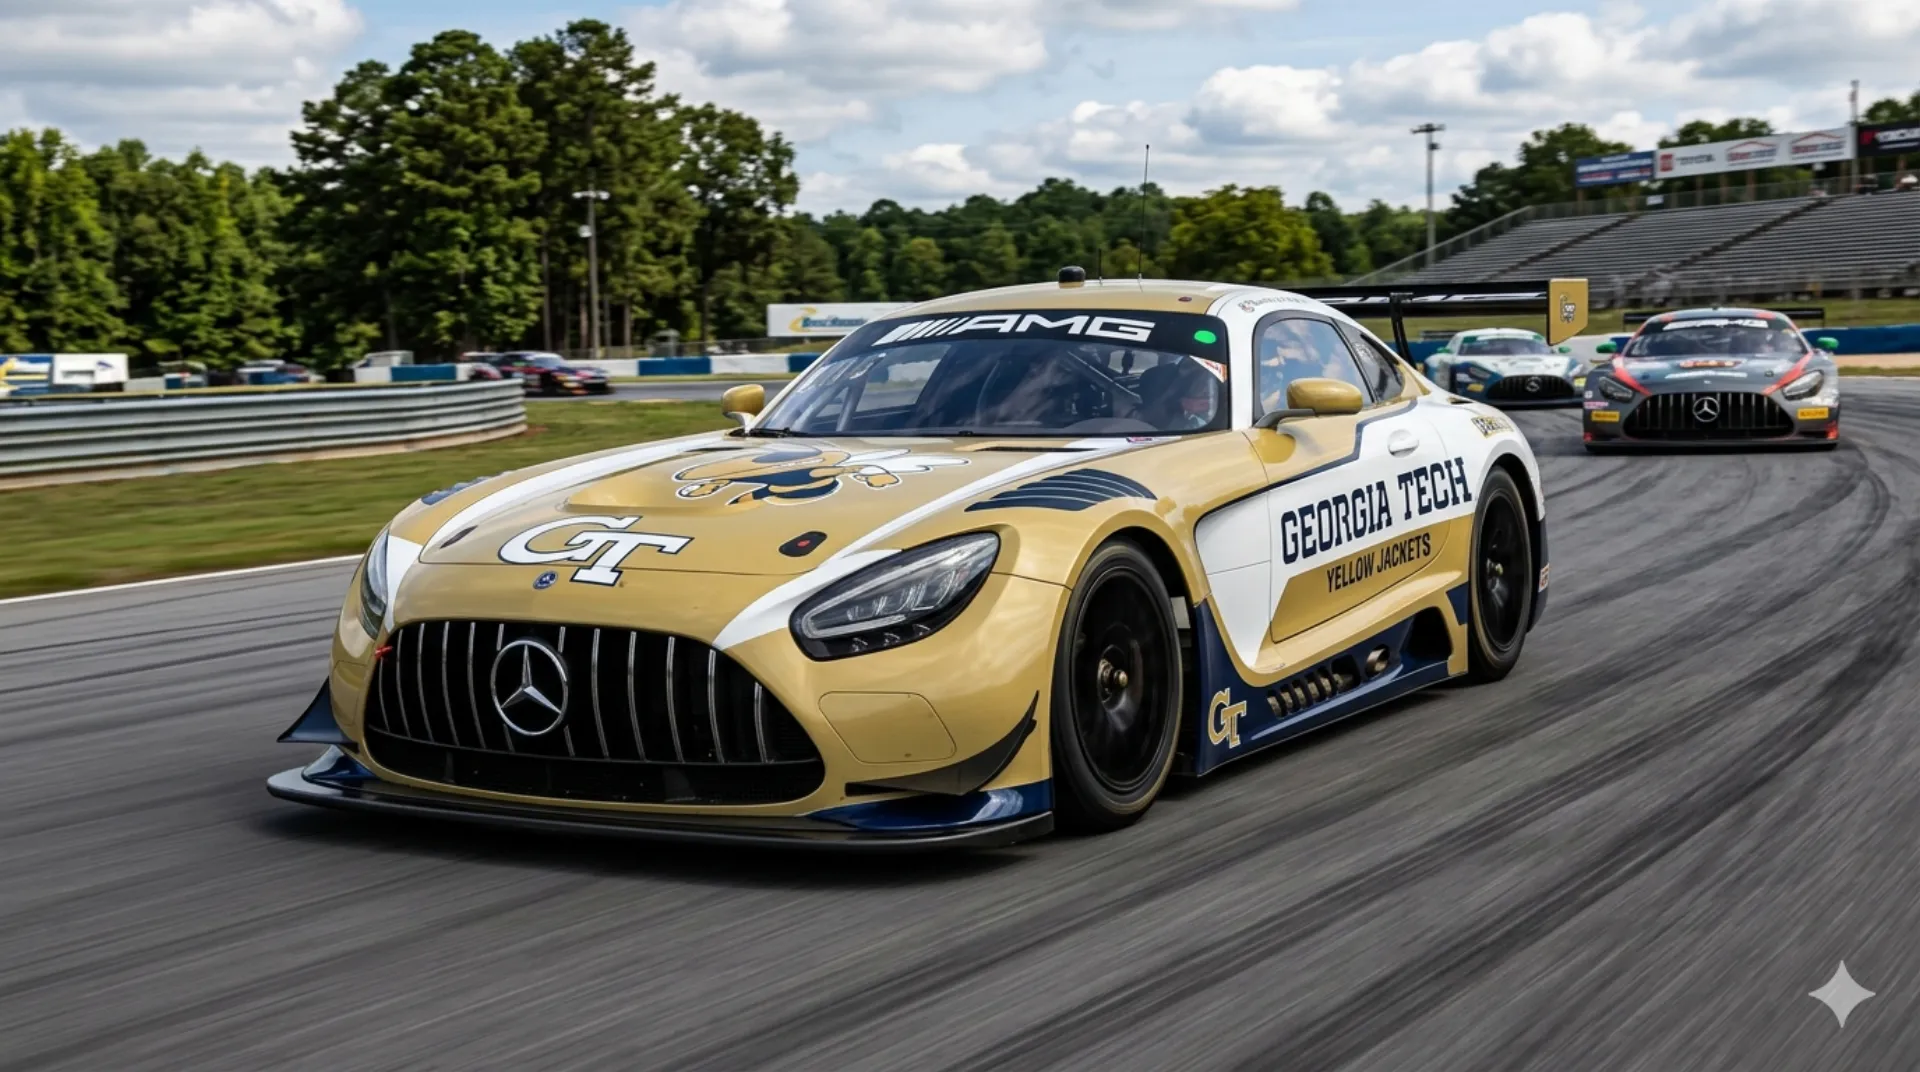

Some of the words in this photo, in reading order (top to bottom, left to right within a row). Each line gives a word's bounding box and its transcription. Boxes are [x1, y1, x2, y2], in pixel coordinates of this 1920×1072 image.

[948, 314, 1156, 343] AMG
[1281, 480, 1393, 564] GEORGIA
[1397, 457, 1472, 521] TECH
[497, 515, 695, 587] GT
[1326, 552, 1375, 592] YELLOW
[1377, 532, 1431, 573] JACKETS
[1208, 687, 1247, 749] GT
